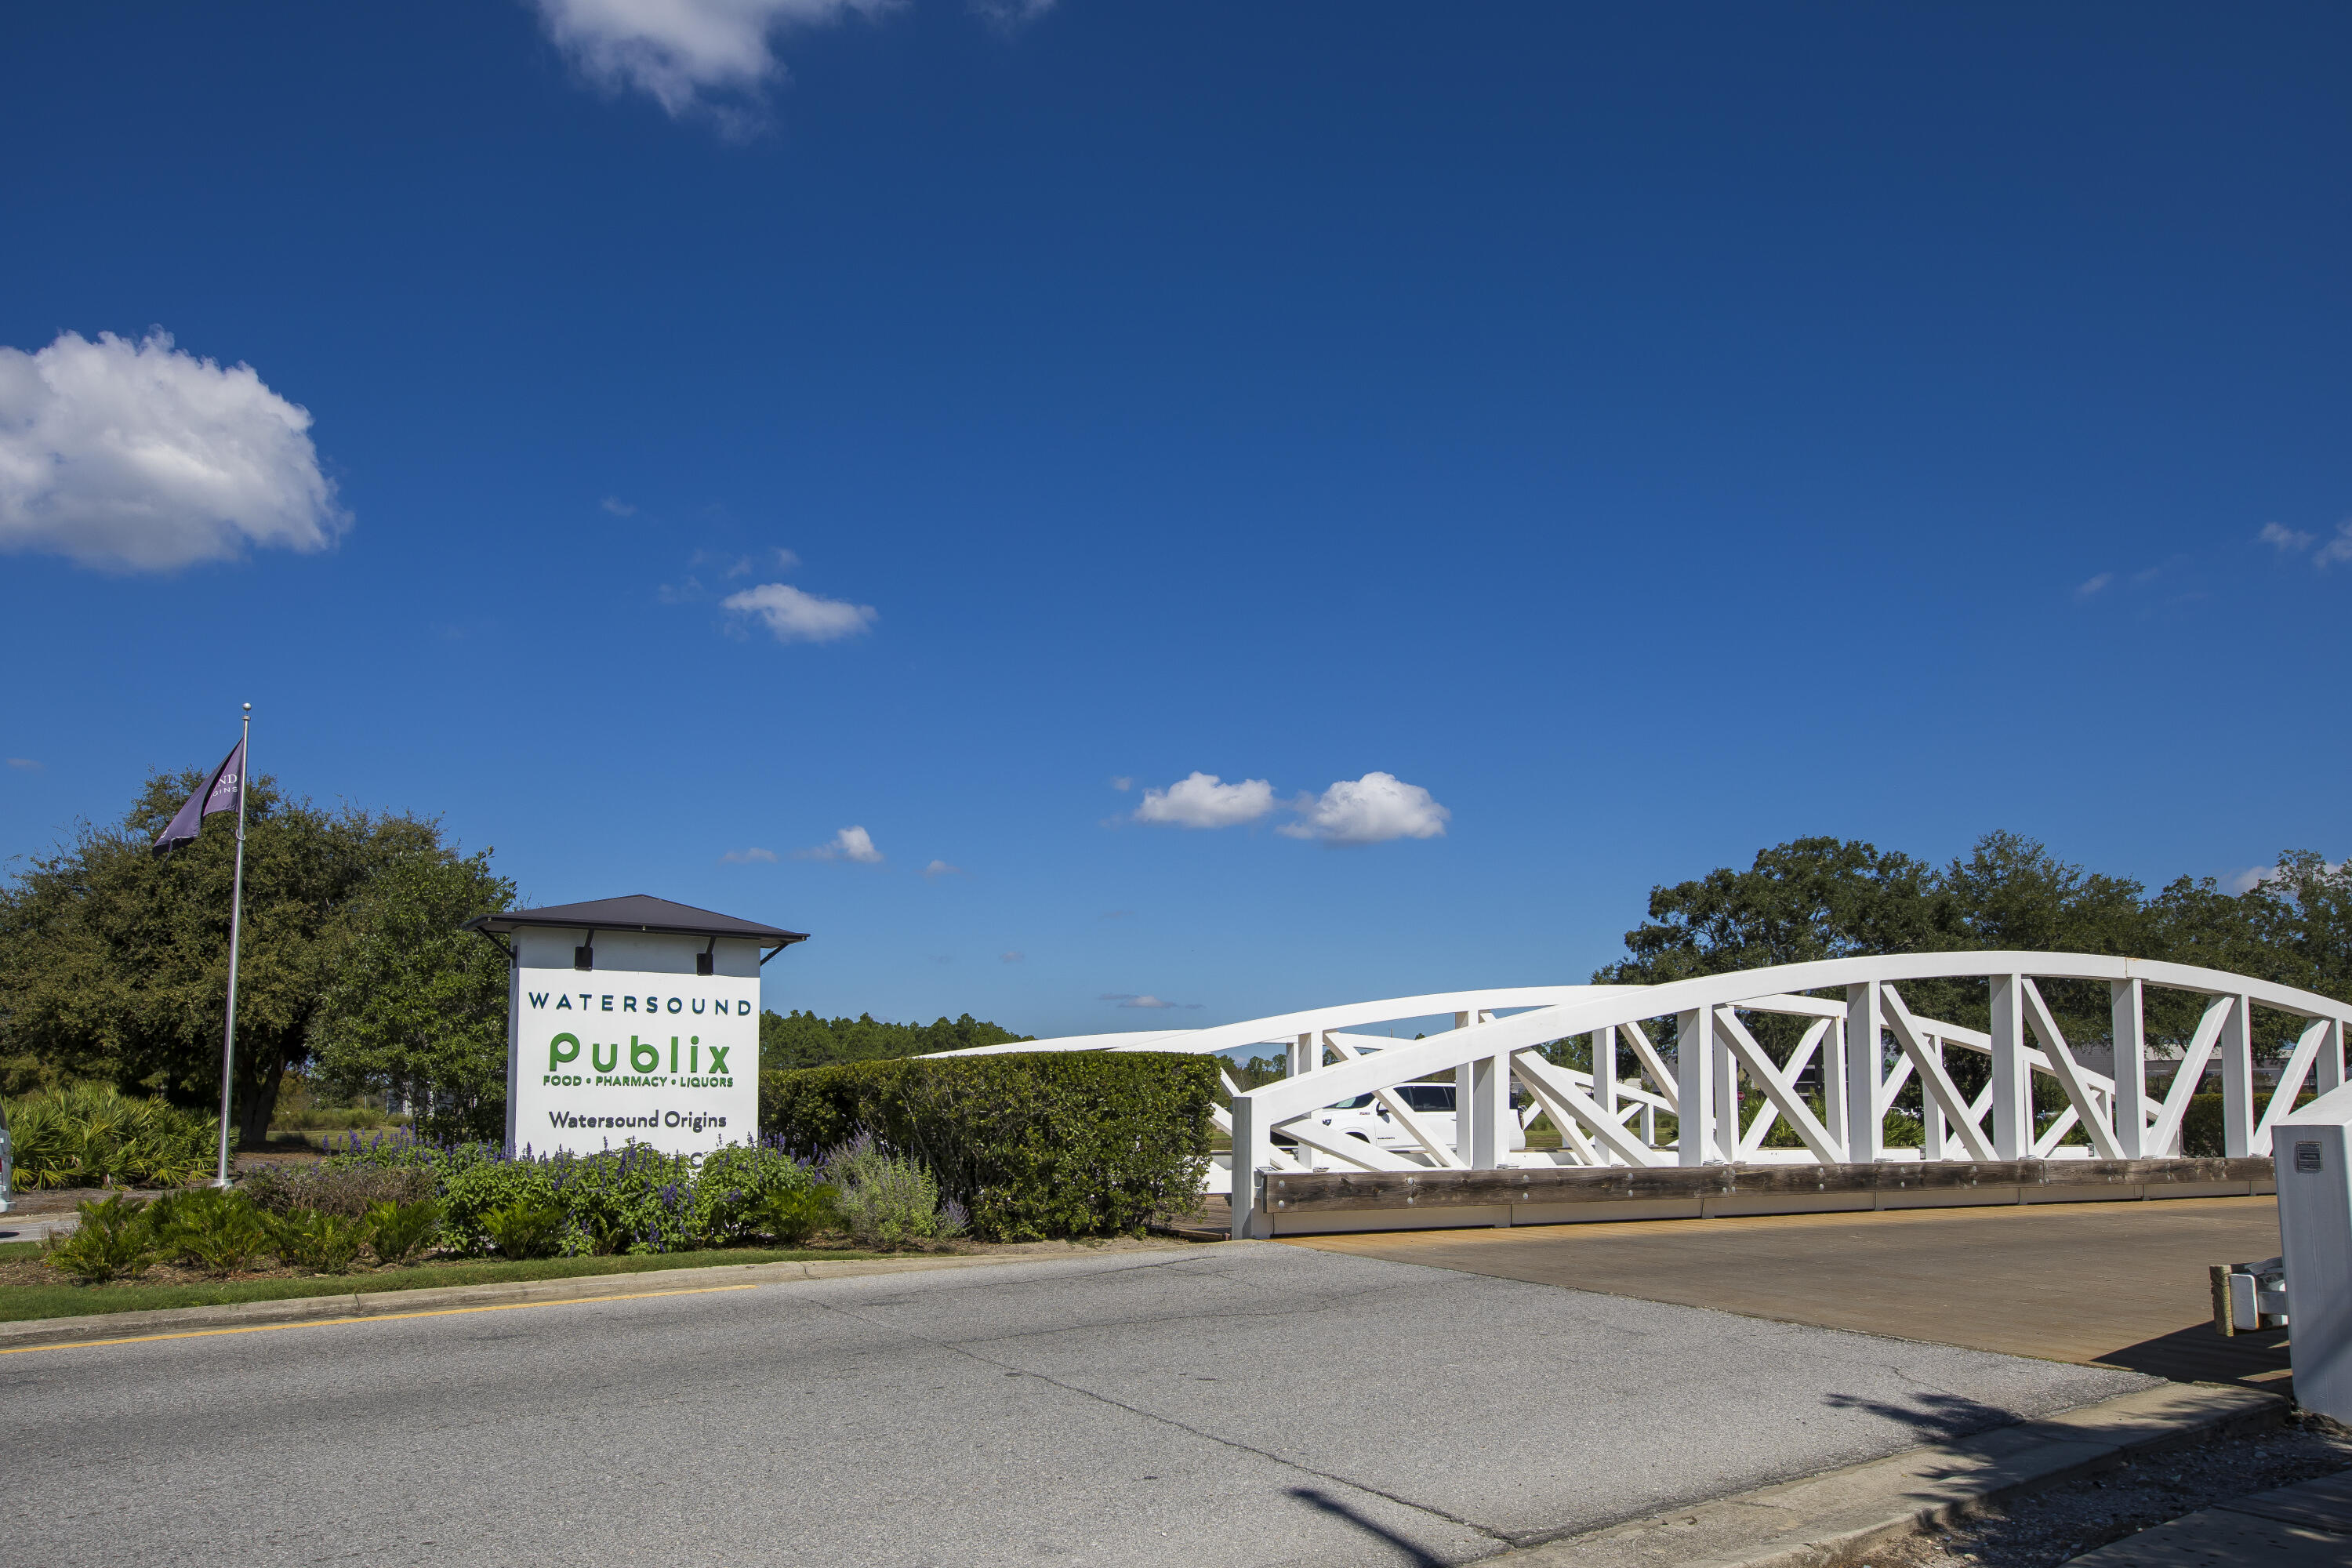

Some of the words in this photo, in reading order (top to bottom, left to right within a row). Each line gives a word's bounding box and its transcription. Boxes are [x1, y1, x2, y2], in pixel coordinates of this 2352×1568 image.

[528, 992, 751, 1016] WATERSOUND
[549, 1033, 729, 1074] Publix
[543, 1075, 583, 1087] FOOD
[595, 1076, 668, 1087] PHARMACY
[680, 1076, 734, 1088] LIQUORS
[548, 1109, 659, 1129] Watersound
[664, 1110, 727, 1134] Origins
